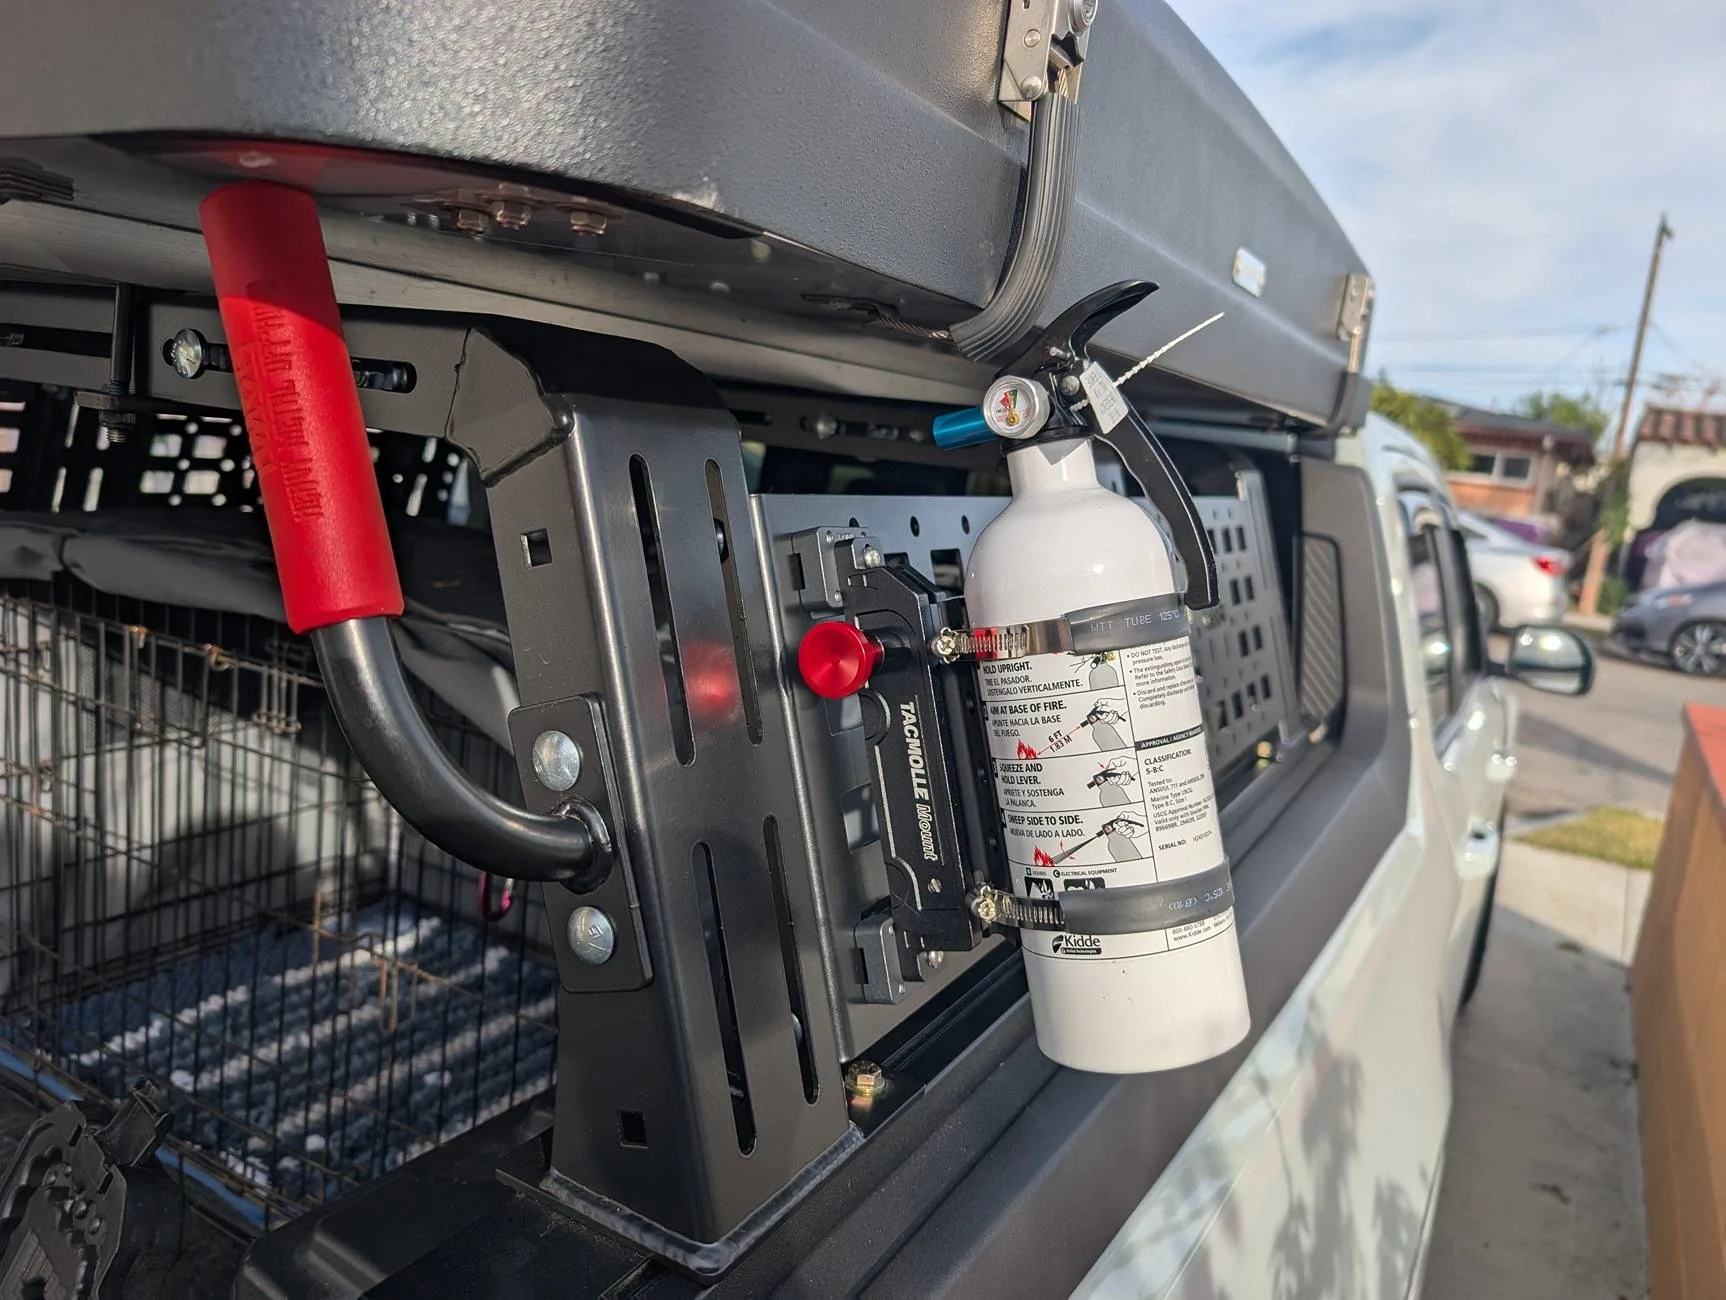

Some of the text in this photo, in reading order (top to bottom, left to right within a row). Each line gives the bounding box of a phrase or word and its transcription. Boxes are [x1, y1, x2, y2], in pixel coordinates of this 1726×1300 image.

[268, 379, 309, 448] METAL
[1124, 615, 1151, 626] TUBE
[983, 661, 1032, 674] HOLD UPRIGHT.
[1144, 662, 1174, 672] extinguishing
[1000, 675, 1032, 685] PASADOR.
[1020, 679, 1083, 694] VERTICALMENTE.
[1137, 688, 1155, 696] Discard
[1138, 693, 1166, 702] Completely
[1000, 706, 1007, 714] AT
[1009, 704, 1028, 714] BASE
[1030, 703, 1041, 713] OF
[1044, 700, 1067, 711] FIRE.
[1010, 718, 1028, 726] HACIA
[1030, 717, 1039, 725] LA
[1041, 715, 1061, 723] BASE
[1002, 729, 1020, 737] FUEGO.
[1054, 730, 1062, 739] FT
[1050, 735, 1072, 753] 1.83 M
[1142, 738, 1169, 748] APPROVAL
[1000, 763, 1042, 773] SQUEEZE AND
[900, 702, 938, 861] TACMOLLE Mount
[1002, 776, 1041, 784] HOLD LEVER.
[1027, 788, 1064, 796] SOSTENGA
[1169, 806, 1188, 814] Approval
[1008, 815, 1083, 825] SWEEP SIDE TO SIDE.
[1010, 828, 1025, 837] MUEVA
[1035, 830, 1052, 838] LADO
[1062, 829, 1085, 837] LADO.
[1061, 869, 1087, 877] ELECTRICAL
[1064, 936, 1100, 947] Kidde
